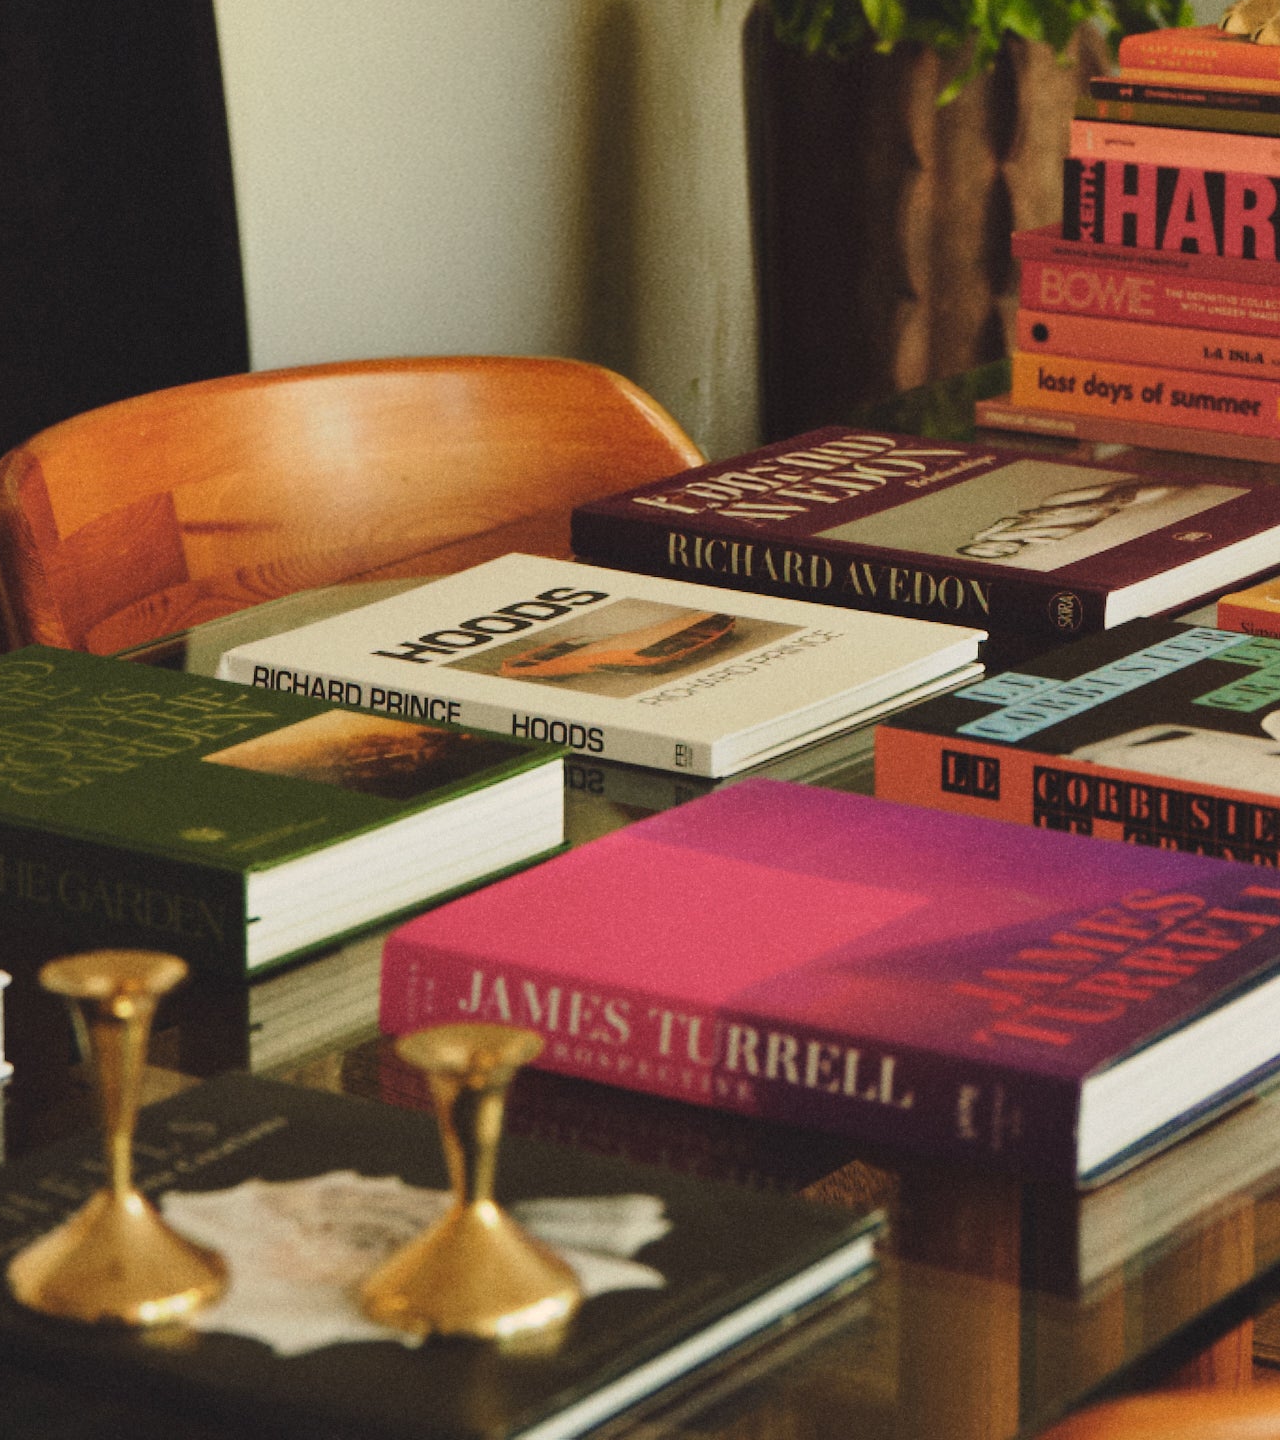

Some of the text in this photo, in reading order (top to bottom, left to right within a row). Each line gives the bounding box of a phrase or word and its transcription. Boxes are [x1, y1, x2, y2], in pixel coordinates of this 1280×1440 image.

[1079, 159, 1097, 243] KEITH
[1037, 366, 1262, 416] last days of summer
[669, 531, 993, 615] RICHARD AVEDON
[370, 586, 611, 664] HOODS
[252, 664, 605, 753] RICHARD PRINCE HOODS
[947, 755, 996, 794] LE
[952, 888, 1206, 1012] JAMES
[458, 969, 632, 1046] JAMES
[647, 1005, 915, 1109] TURRELL
[553, 1042, 759, 1103] ROSPECTIVE
